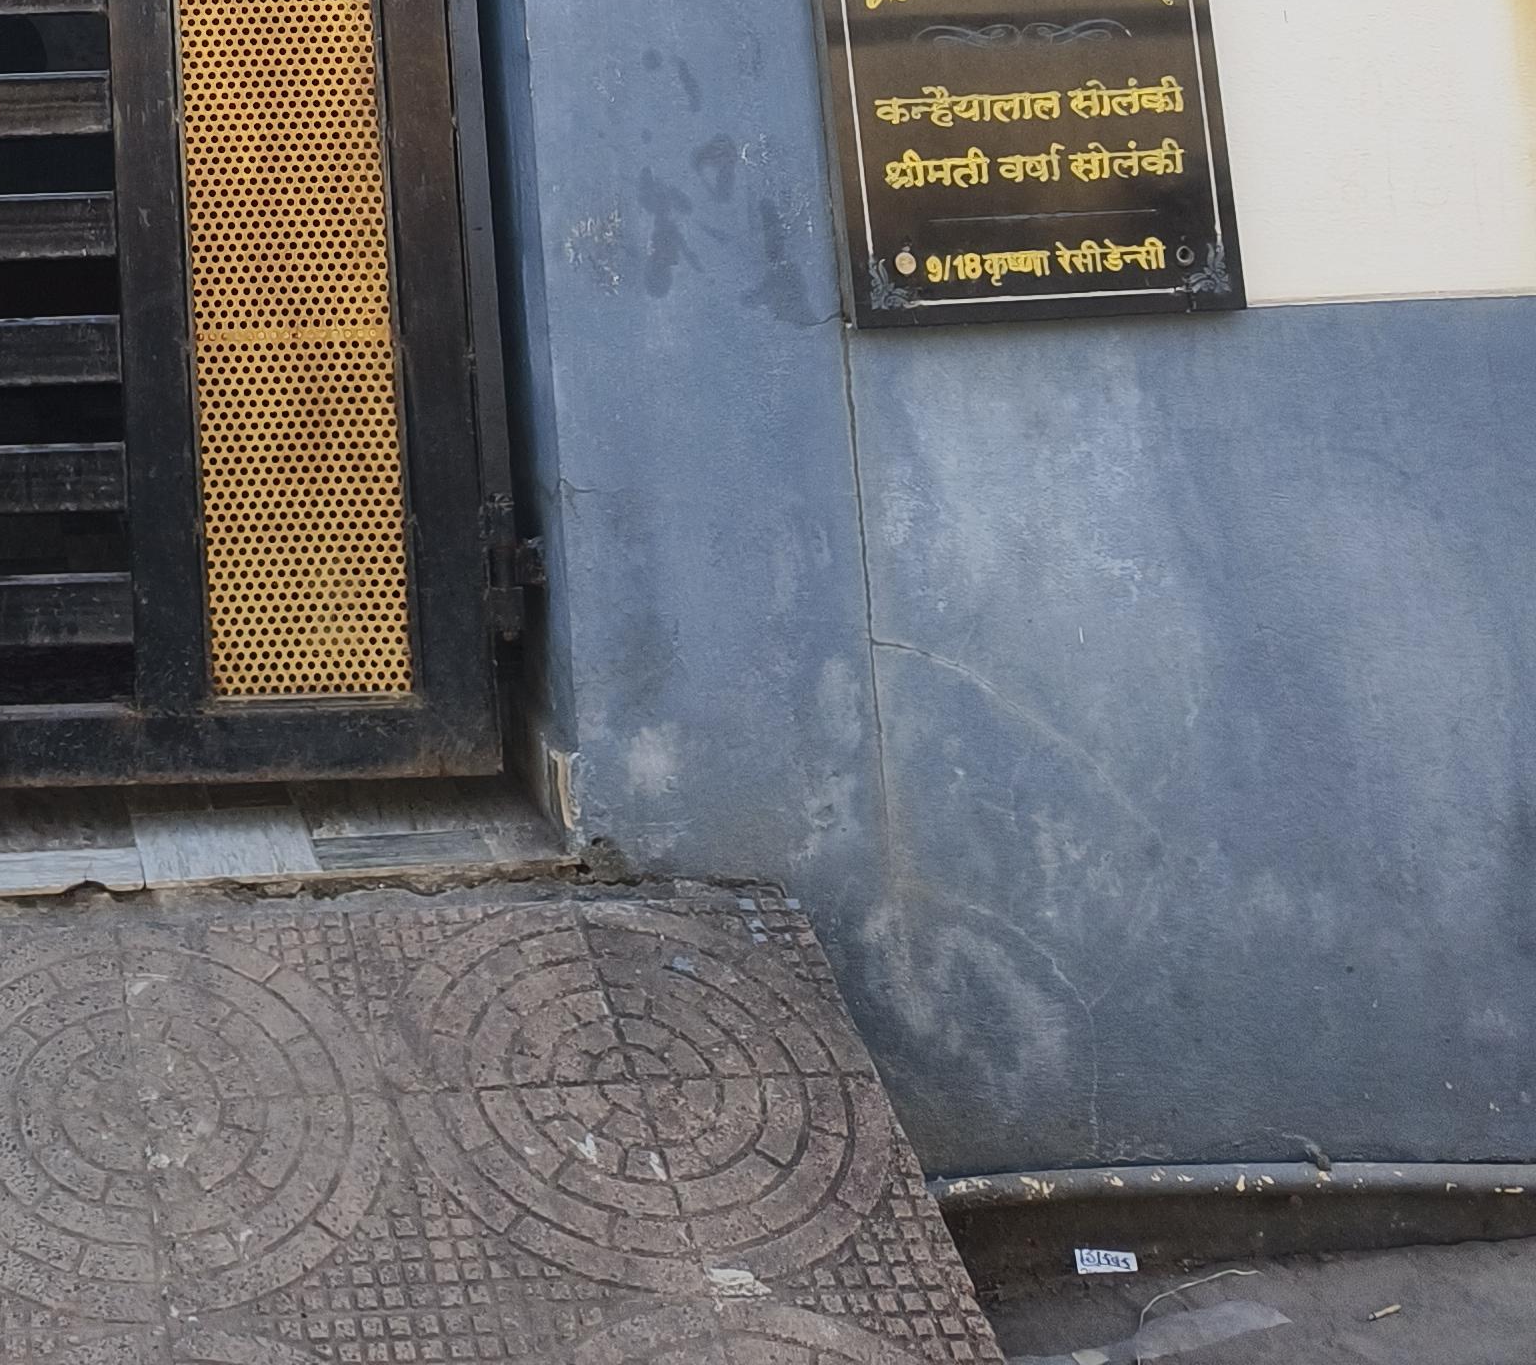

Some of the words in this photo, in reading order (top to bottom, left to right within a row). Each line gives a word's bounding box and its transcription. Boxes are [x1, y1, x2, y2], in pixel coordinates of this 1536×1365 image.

[874, 85, 1063, 128] कन्हैयालाल
[1066, 75, 1185, 118] सोलंकी
[884, 146, 990, 189] श्रीमती
[996, 141, 1066, 183] वर्षा
[1067, 136, 1186, 182] सोलंकी
